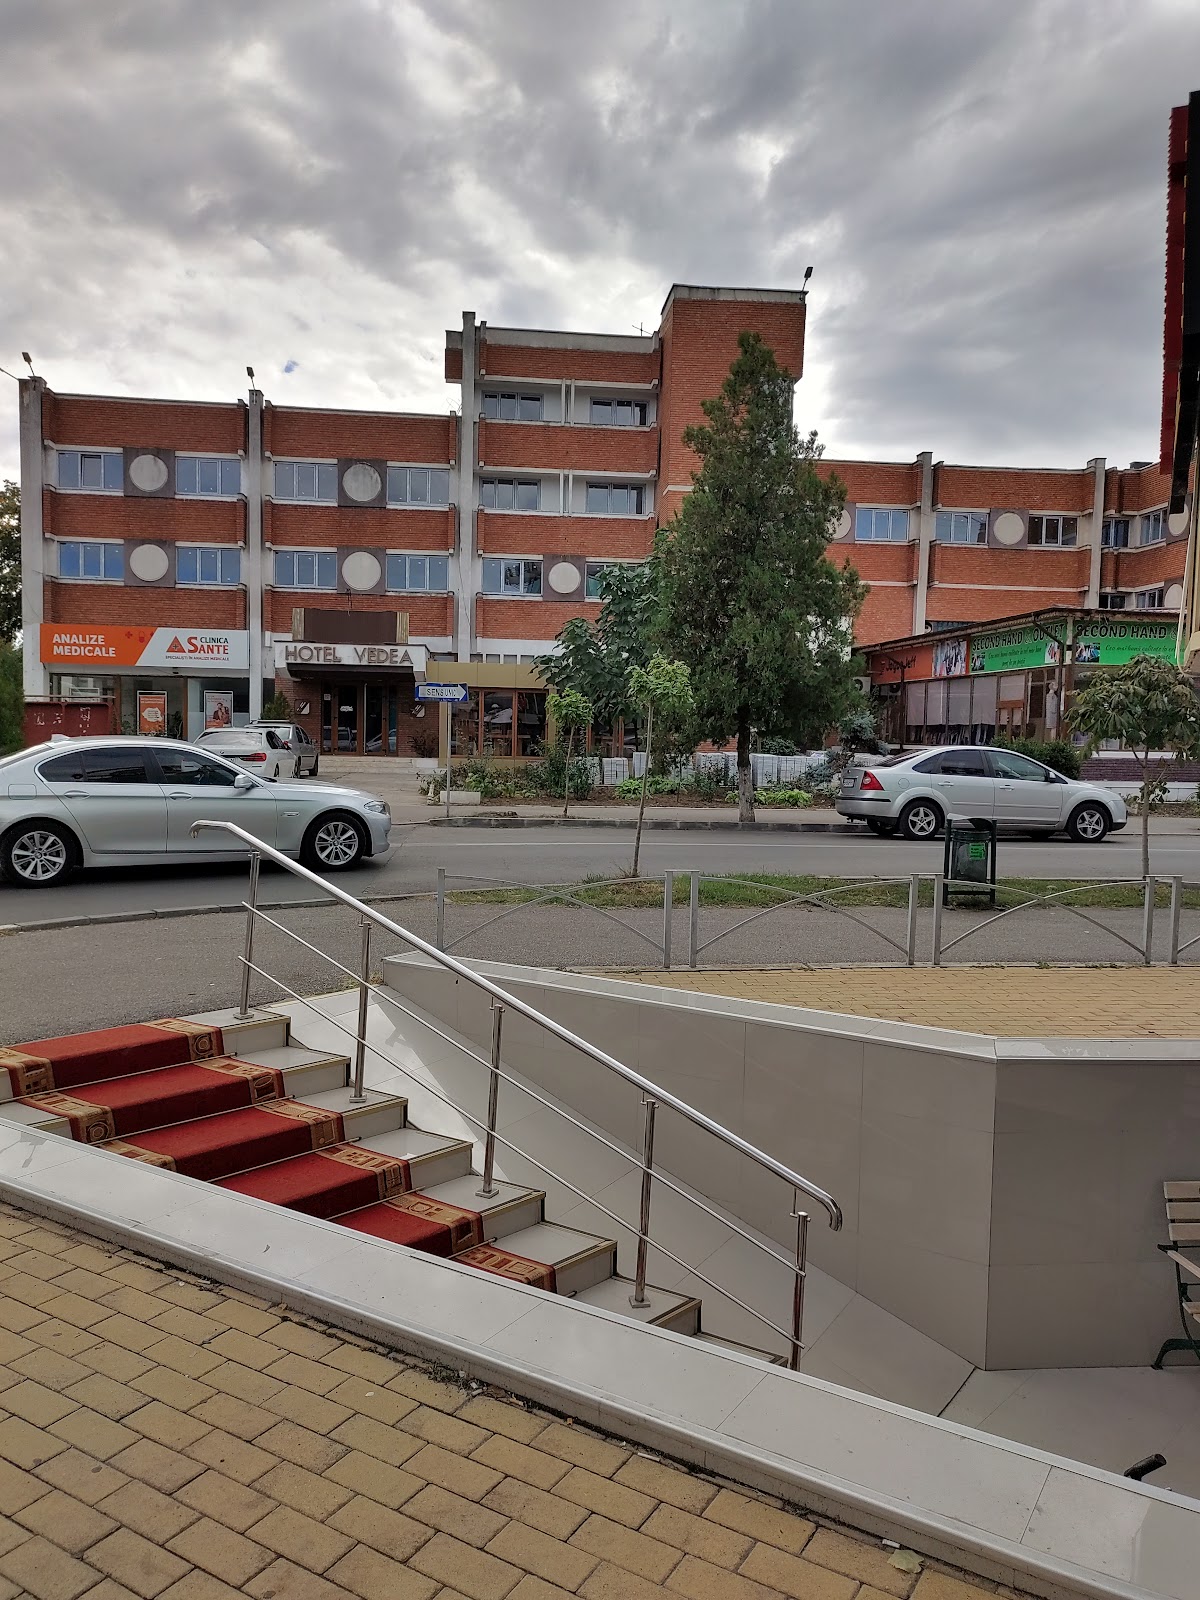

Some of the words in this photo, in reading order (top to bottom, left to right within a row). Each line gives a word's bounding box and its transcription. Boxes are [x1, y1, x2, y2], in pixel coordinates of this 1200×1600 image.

[972, 635, 1000, 651] SECOND
[1001, 630, 1024, 647] HAND
[1033, 623, 1065, 642] OUTLET
[1076, 624, 1127, 639] SECOND
[1130, 625, 1167, 639] HAND
[53, 634, 105, 645] ANALIZE
[187, 636, 229, 655] SANTE
[200, 636, 229, 644] CLINICA
[53, 645, 116, 657] MEDICALE
[284, 645, 342, 663] HOTEL
[354, 646, 414, 665] VEDEA
